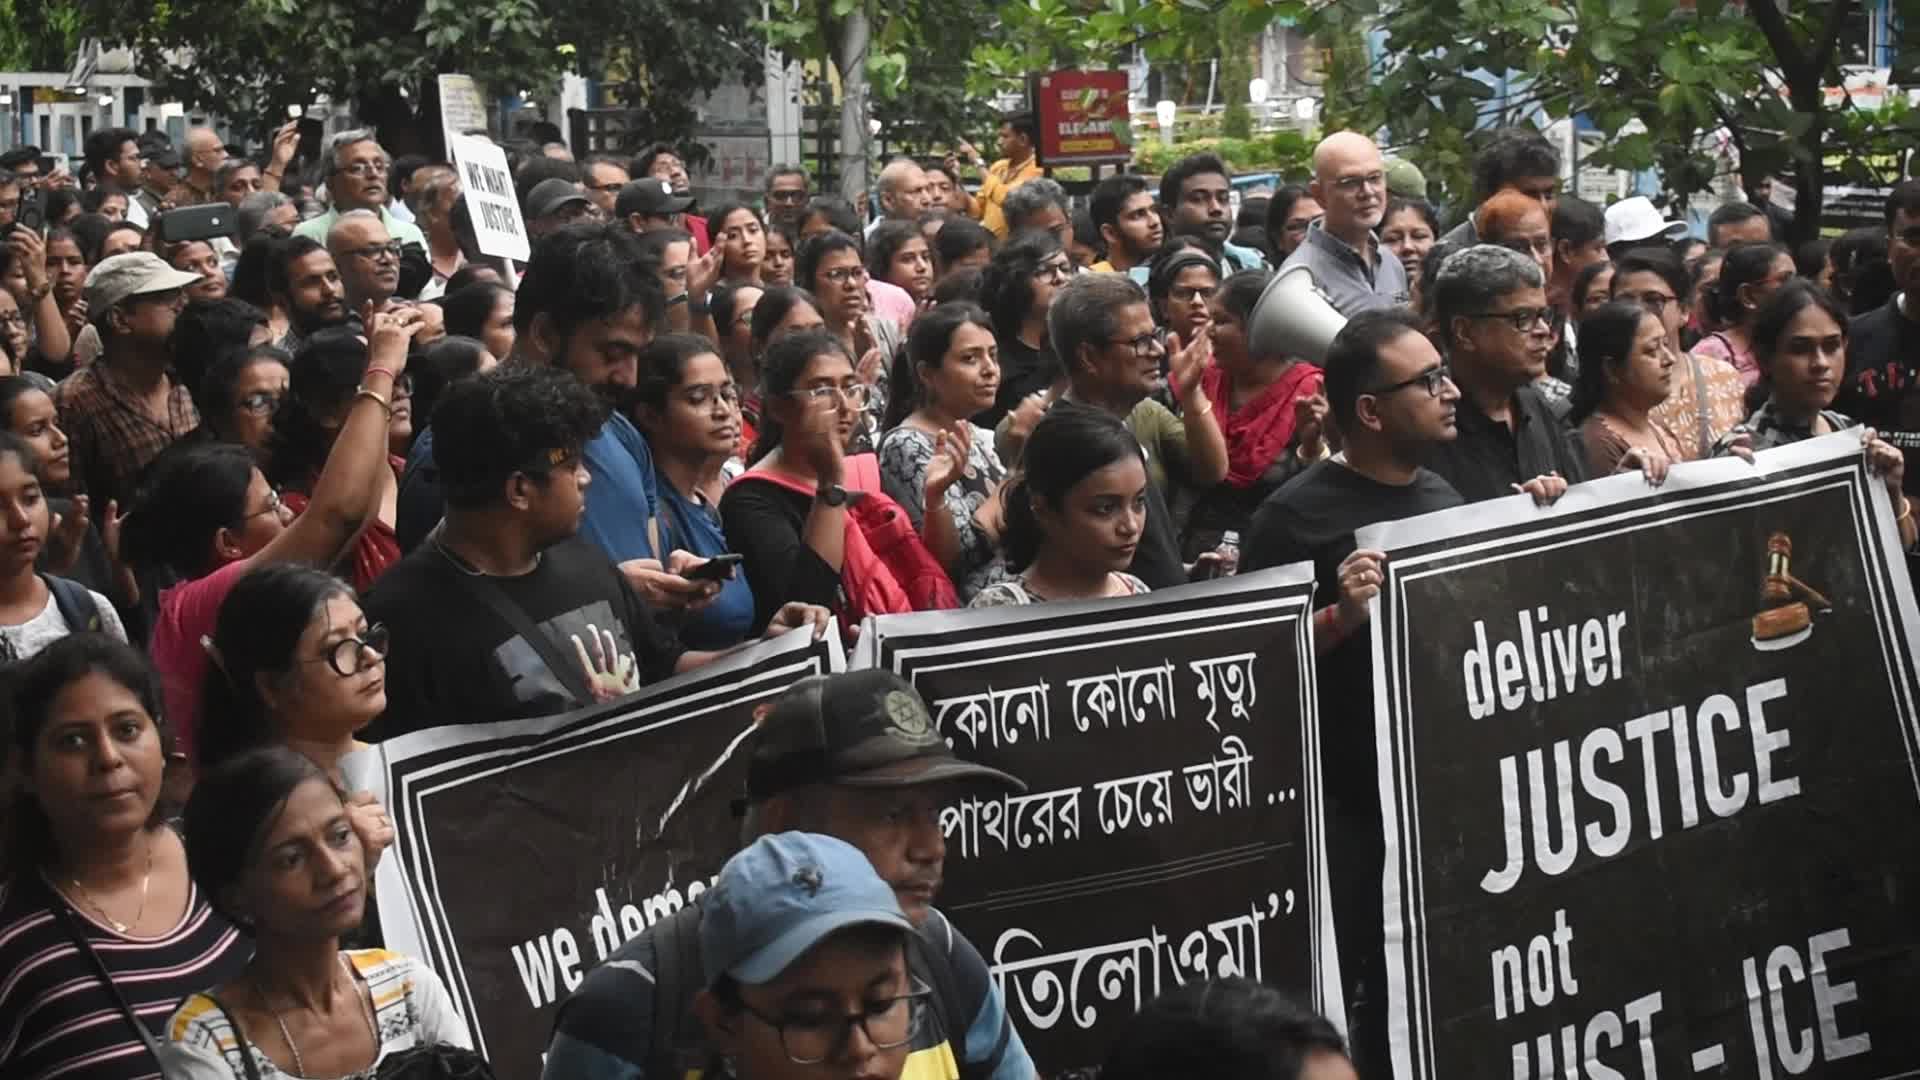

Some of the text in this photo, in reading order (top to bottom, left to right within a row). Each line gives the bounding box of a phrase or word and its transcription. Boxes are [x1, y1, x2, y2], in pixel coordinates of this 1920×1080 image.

[464, 159, 511, 200] WE WANT
[934, 652, 1256, 749] কোনো কোনো মৃত্যু
[1463, 605, 1626, 720] deliver
[938, 787, 1082, 859] পাথরের
[1094, 770, 1173, 835] চেয়ে
[1183, 735, 1253, 815] ভারী
[1480, 678, 1800, 893] JUSTICE
[511, 928, 585, 1008] we
[1491, 909, 1579, 1021] not
[1742, 928, 1872, 1080] ICE
